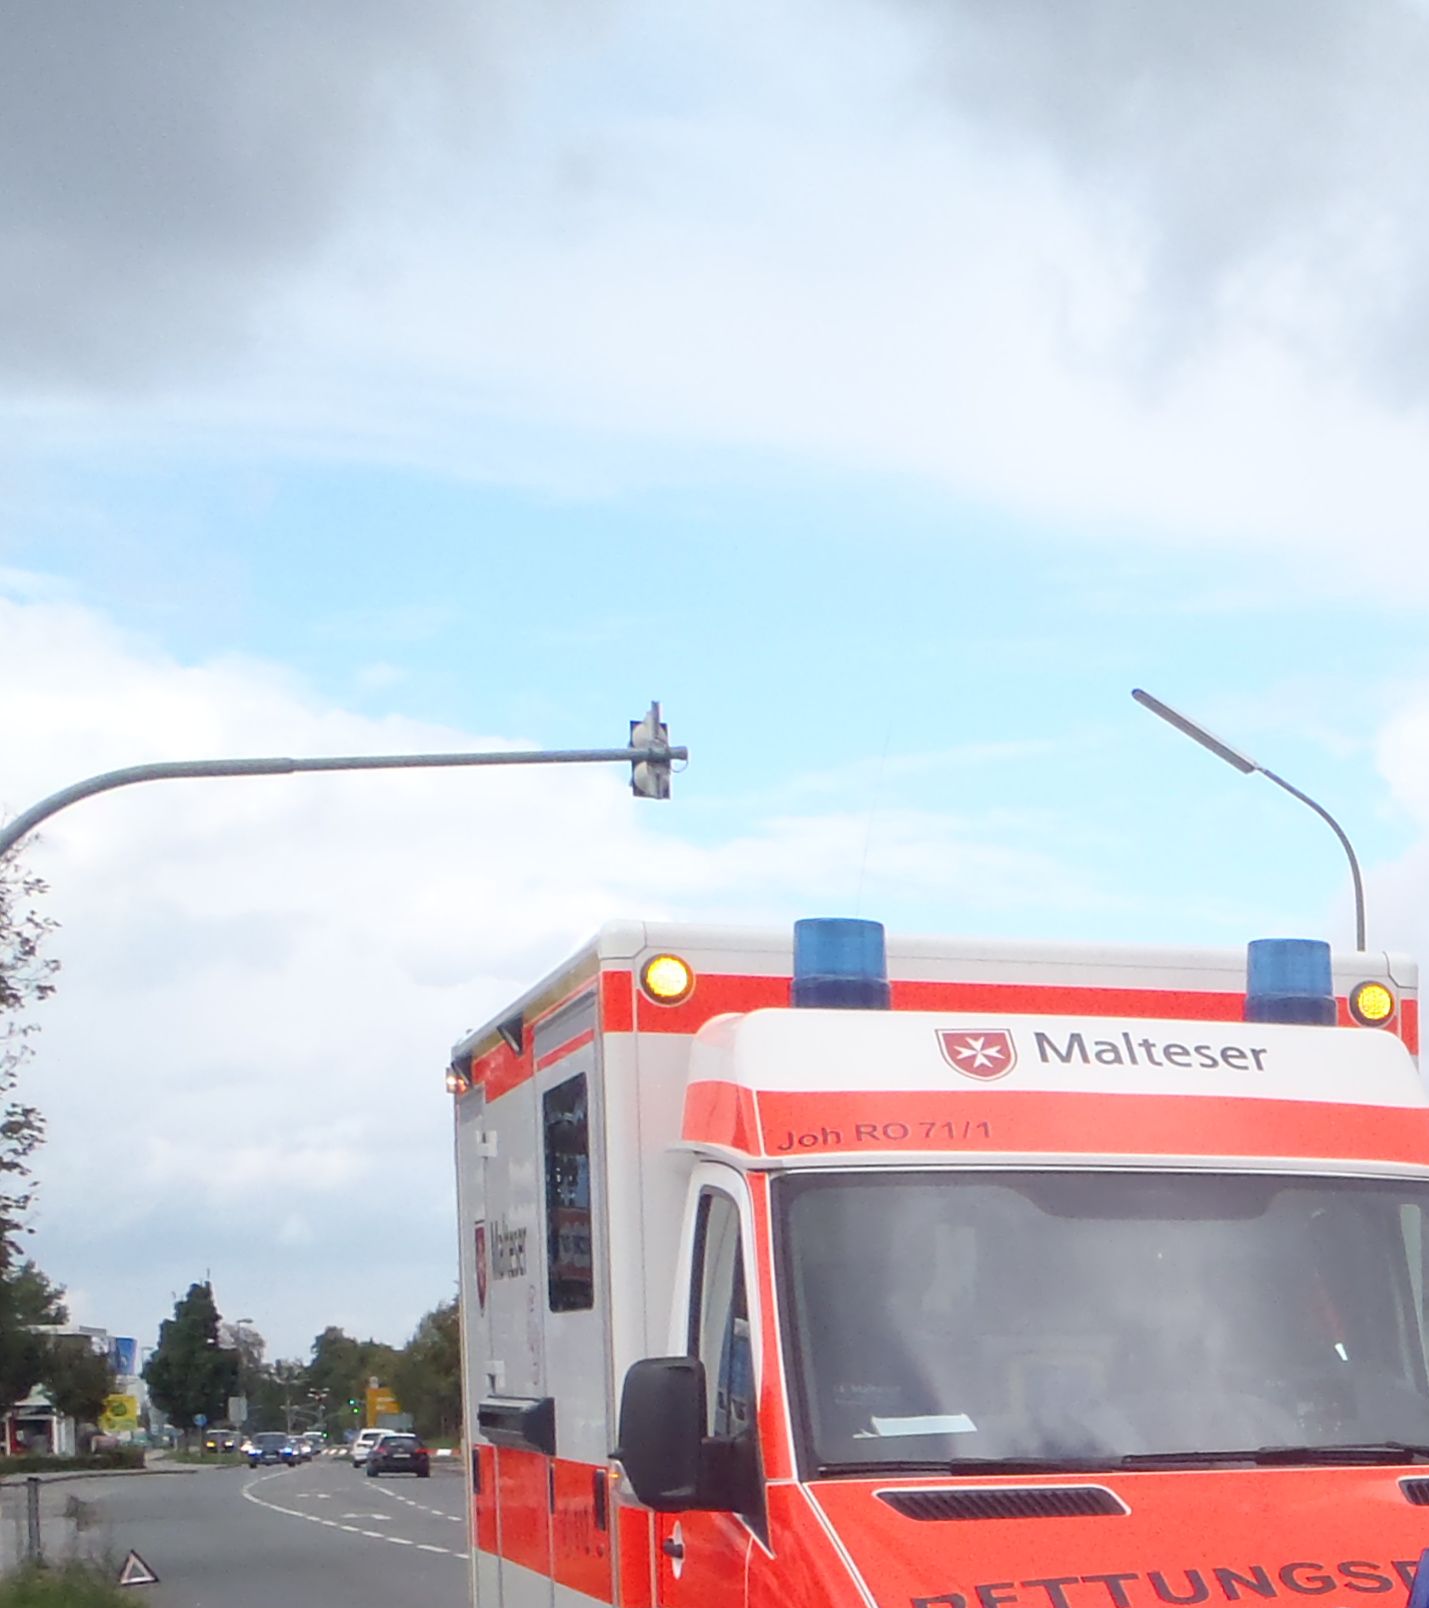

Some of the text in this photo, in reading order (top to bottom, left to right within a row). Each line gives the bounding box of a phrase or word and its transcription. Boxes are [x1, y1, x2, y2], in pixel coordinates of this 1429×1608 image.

[1033, 1031, 1268, 1071] Malteser
[777, 1120, 991, 1151] Joh RO 71/1
